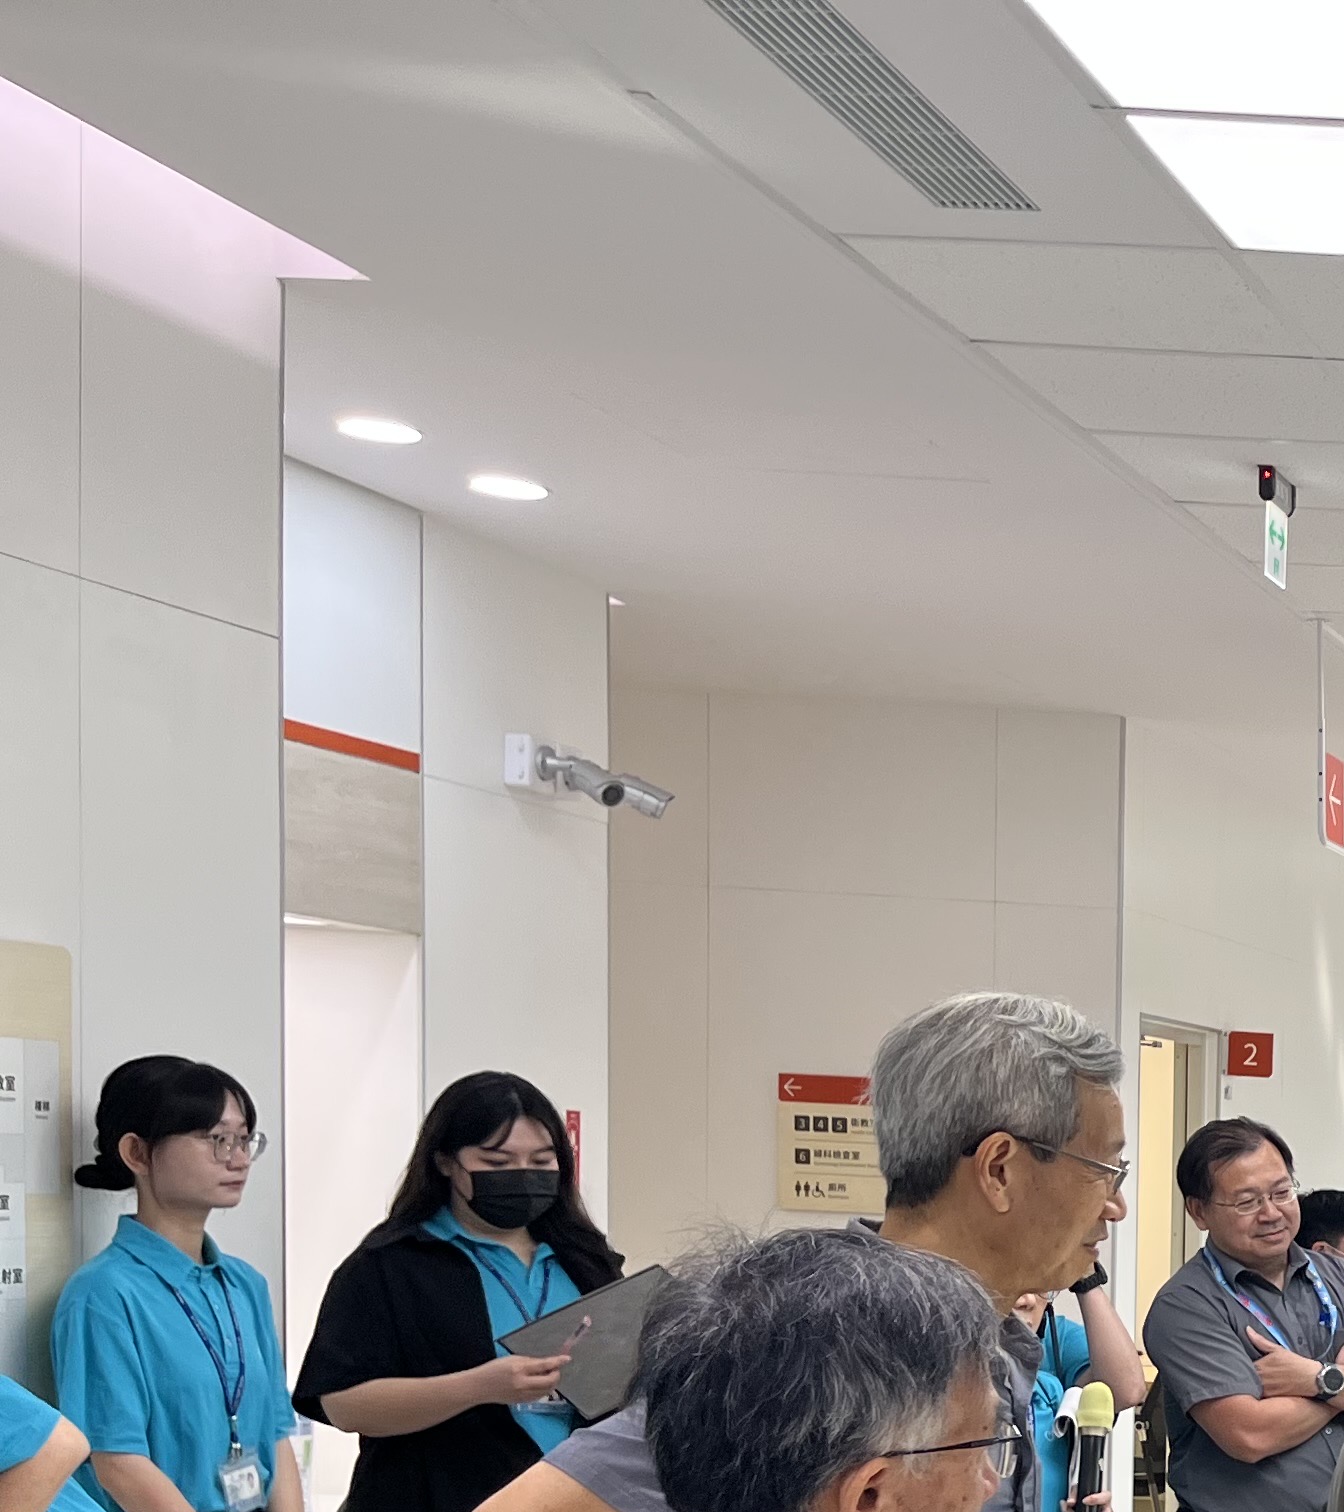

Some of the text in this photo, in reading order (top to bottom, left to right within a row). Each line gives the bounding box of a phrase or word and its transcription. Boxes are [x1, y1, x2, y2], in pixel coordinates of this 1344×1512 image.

[1243, 1042, 1258, 1067] 2
[817, 1119, 824, 1130] 4
[836, 1120, 843, 1131] 5
[851, 1117, 873, 1127] 衛教
